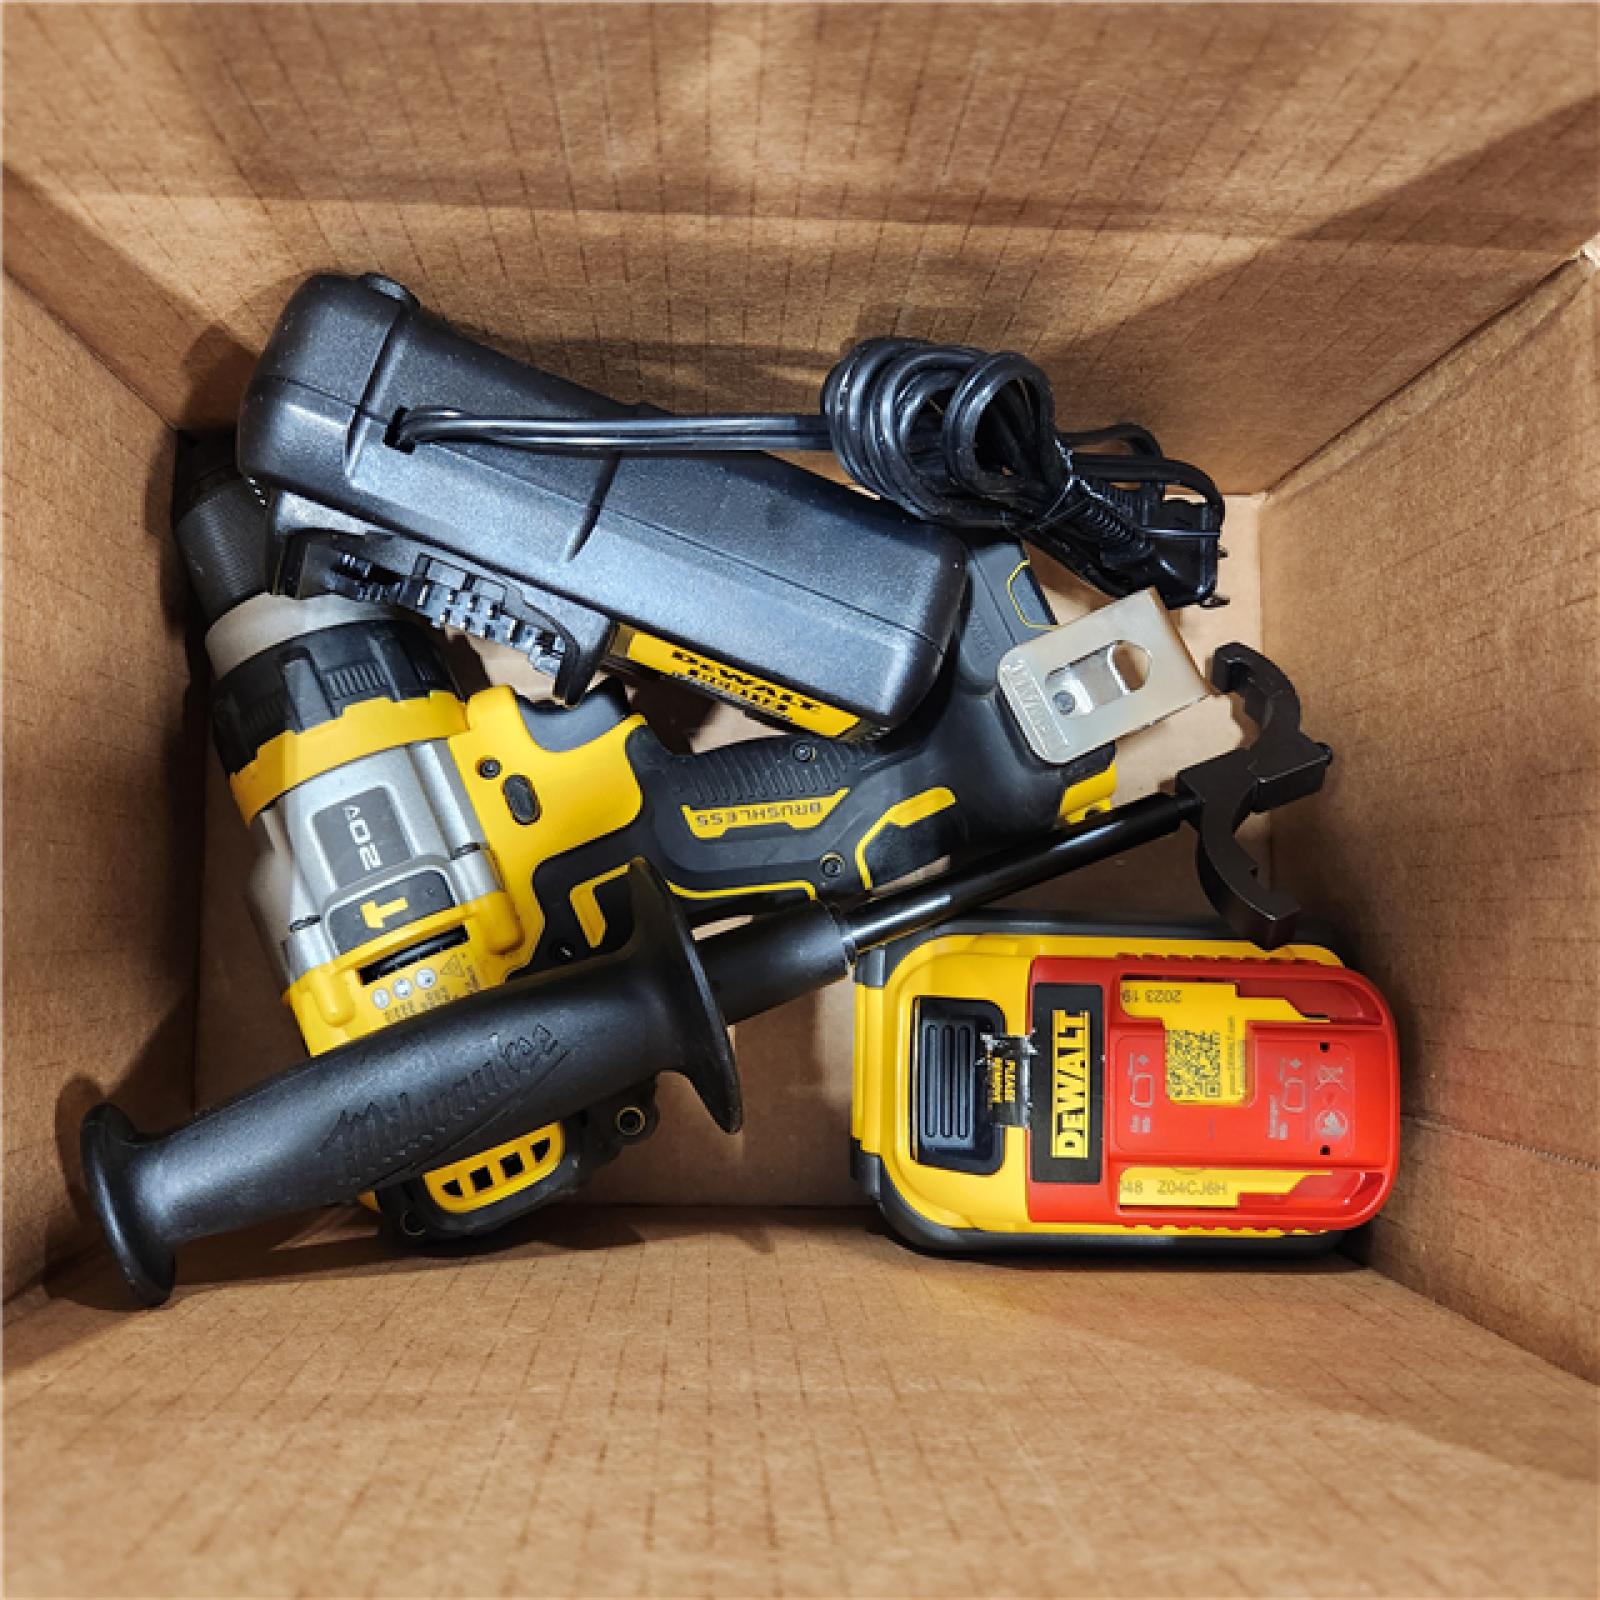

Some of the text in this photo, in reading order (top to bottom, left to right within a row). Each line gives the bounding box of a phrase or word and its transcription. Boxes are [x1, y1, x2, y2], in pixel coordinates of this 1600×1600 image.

[695, 802, 822, 827] BRUSHLESS
[343, 805, 382, 870] 20V
[1145, 989, 1183, 1003] 2023
[1051, 1010, 1091, 1159] DEWALT
